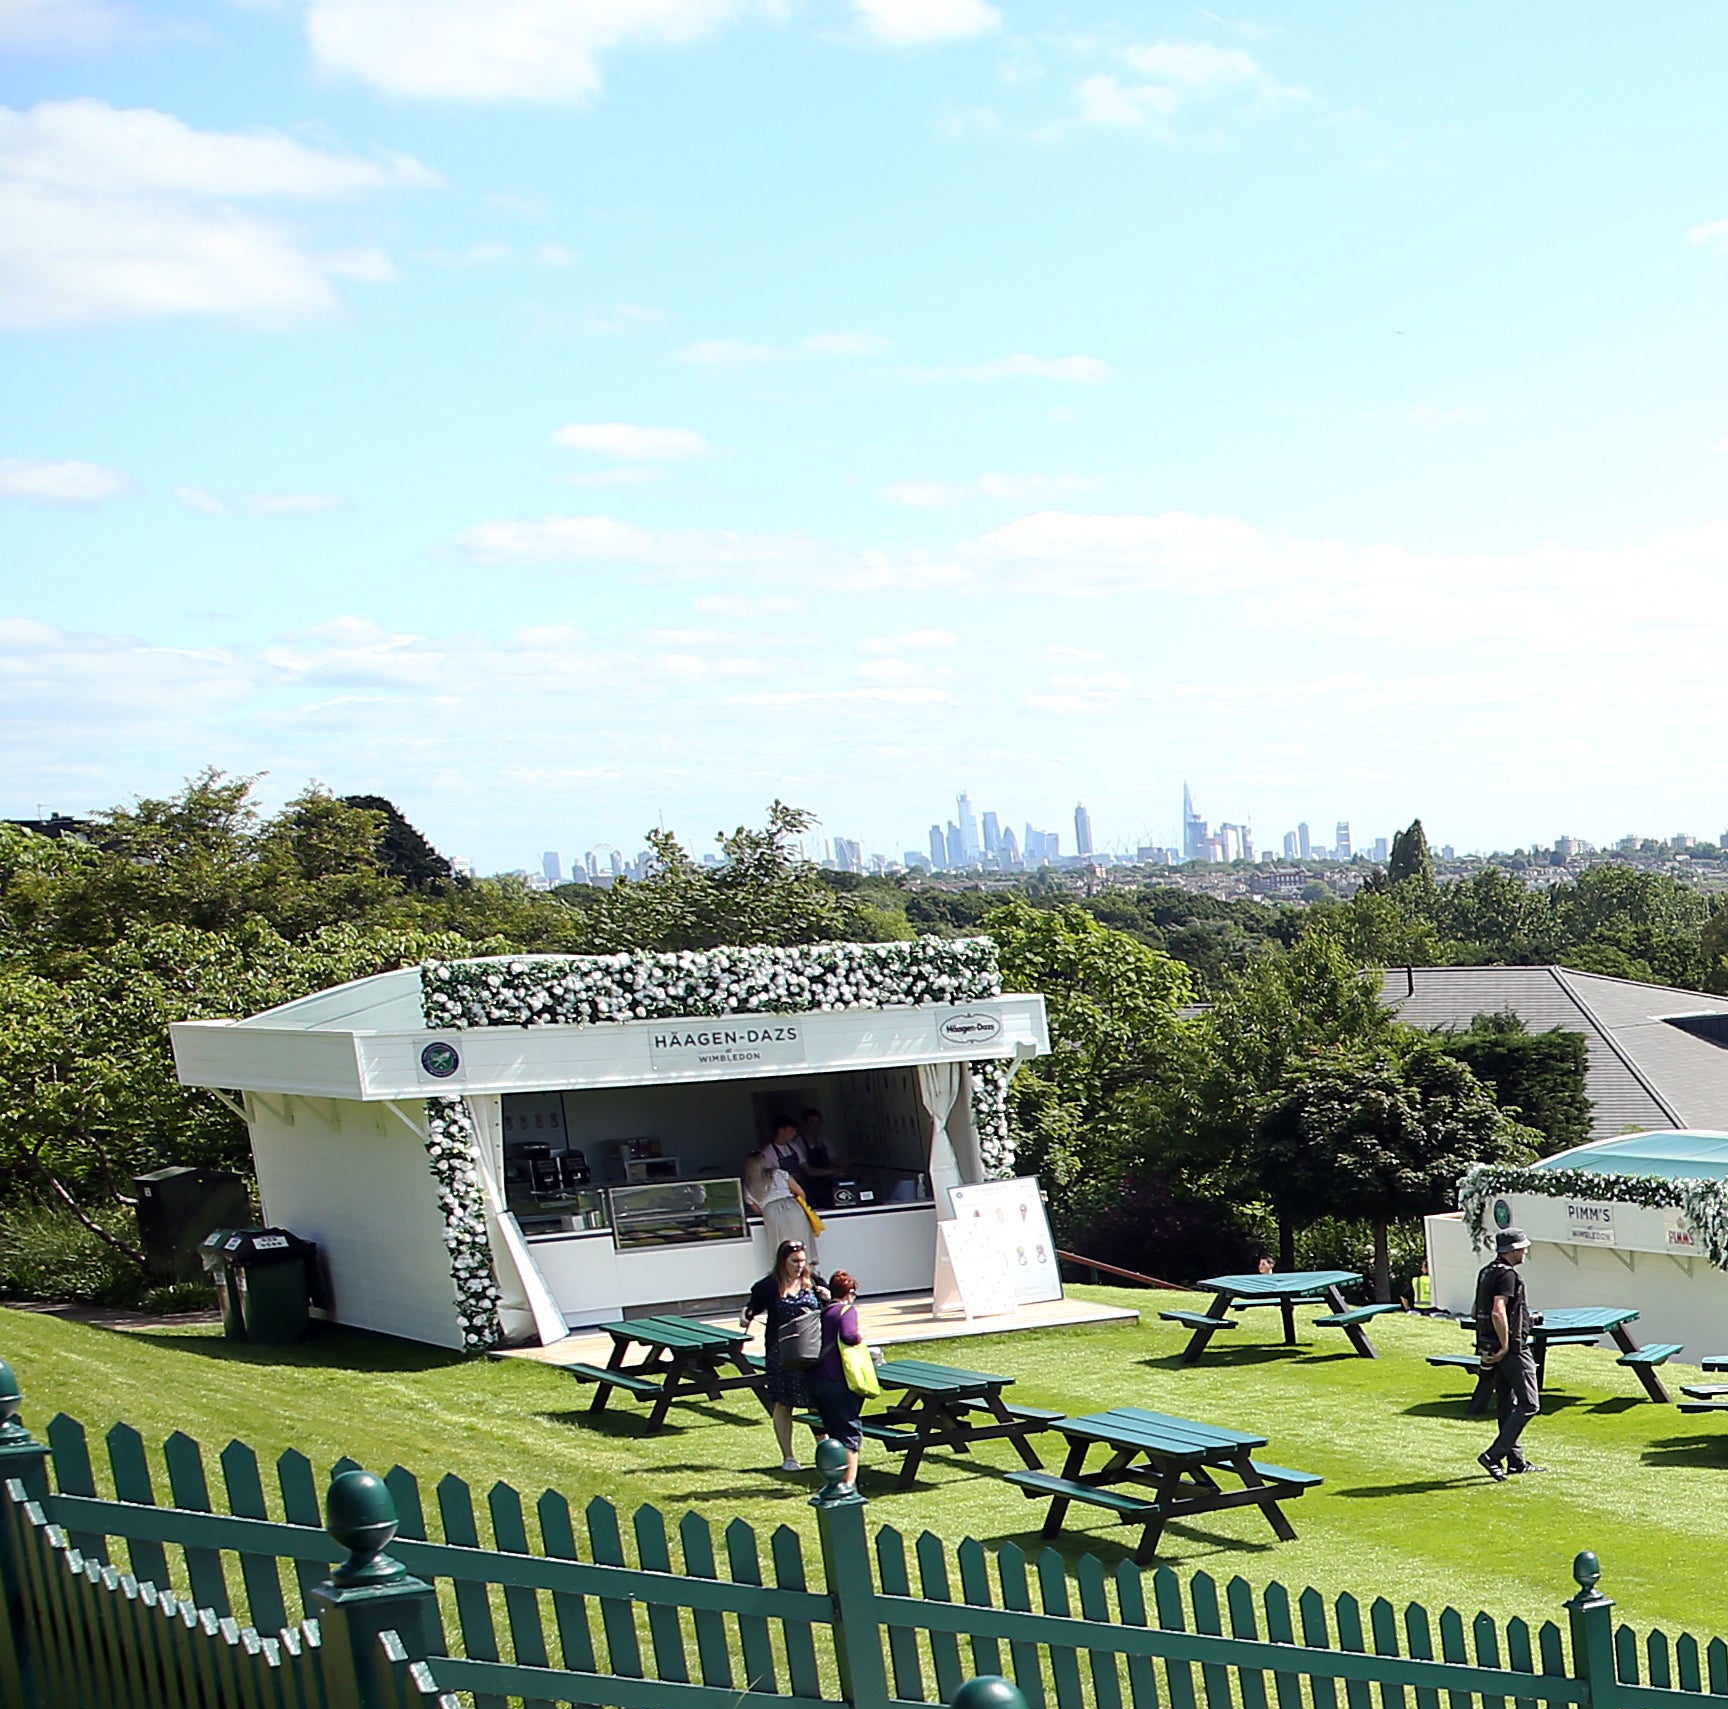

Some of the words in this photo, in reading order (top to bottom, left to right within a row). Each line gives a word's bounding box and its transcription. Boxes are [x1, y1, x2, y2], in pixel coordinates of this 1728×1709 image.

[654, 1027, 798, 1049] HÄAGEN-DAZS
[698, 1052, 760, 1063] WIMBLEDON
[1568, 1205, 1610, 1222] PIMM'S
[1668, 1230, 1694, 1246] PIMMS
